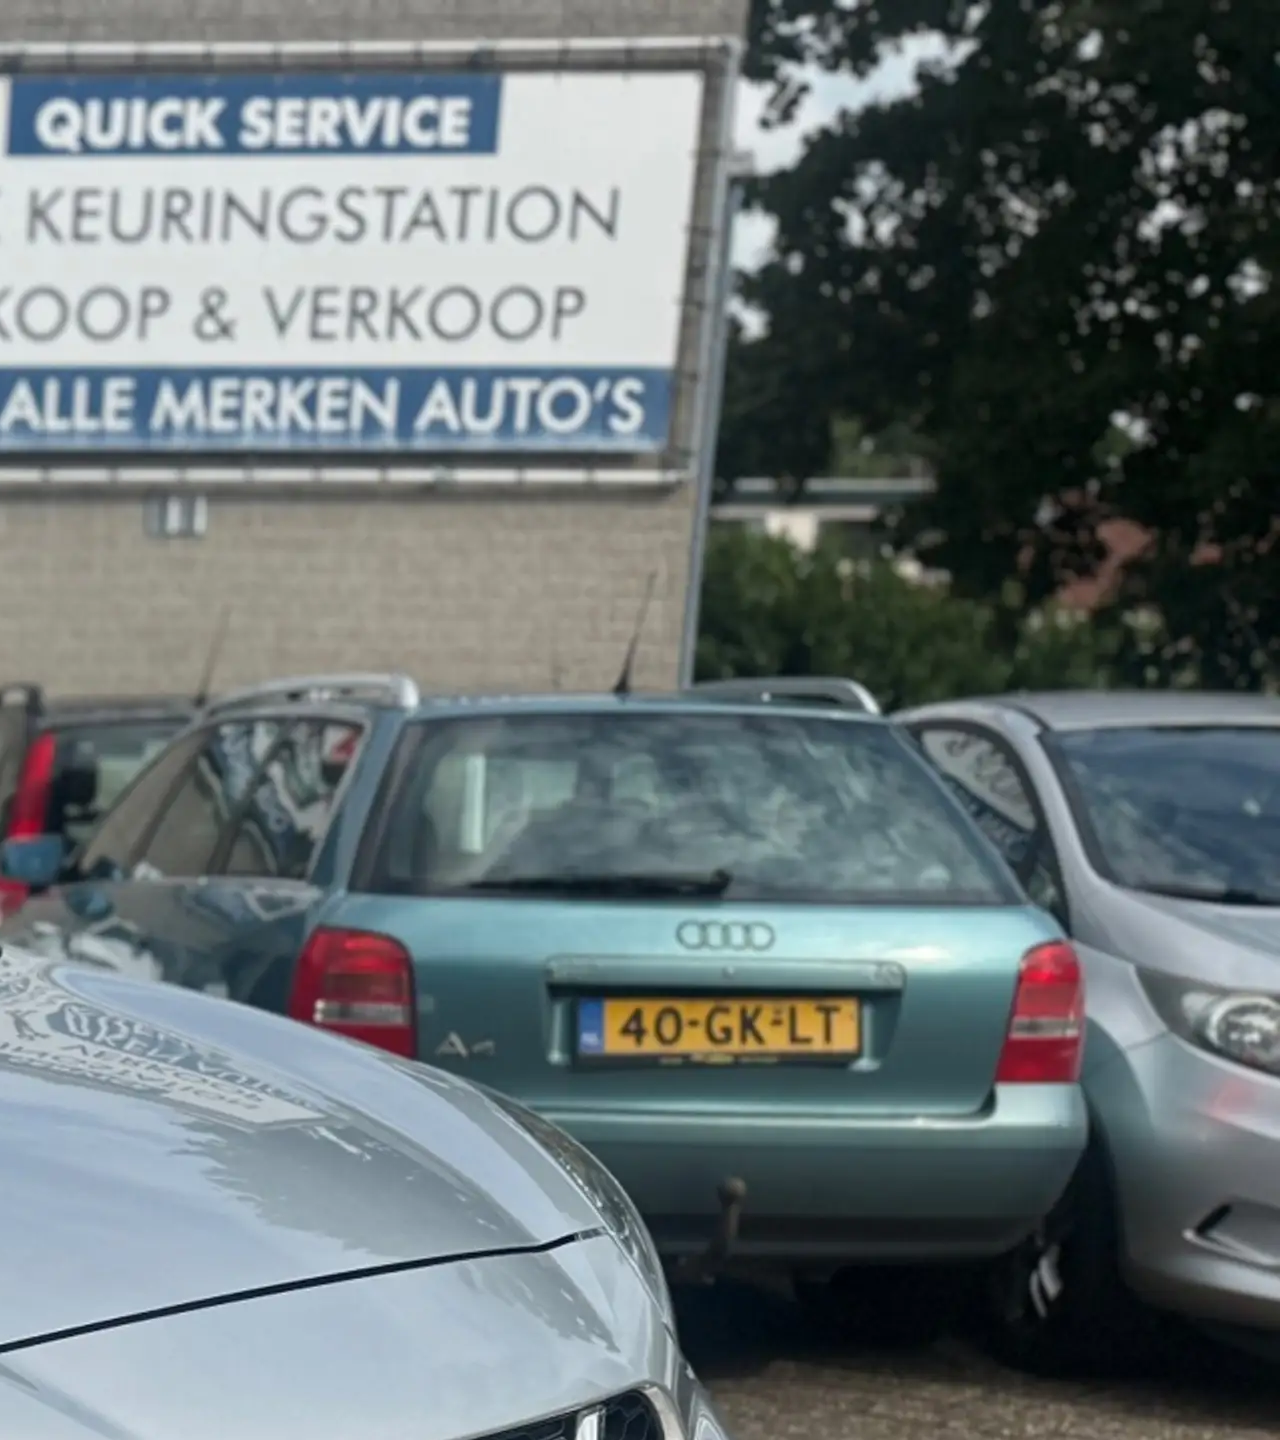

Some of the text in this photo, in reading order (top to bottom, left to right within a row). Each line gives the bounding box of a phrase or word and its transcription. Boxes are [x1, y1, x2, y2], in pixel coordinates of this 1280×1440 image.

[34, 96, 473, 152] QUICK SERVICE
[26, 186, 622, 244] KEURINGSTATION
[192, 286, 239, 343] &
[263, 284, 589, 342] VERKOOP
[148, 376, 401, 434] MERKEN
[413, 376, 645, 434] AUTO'S
[618, 1004, 843, 1046] 40-GK-LT
